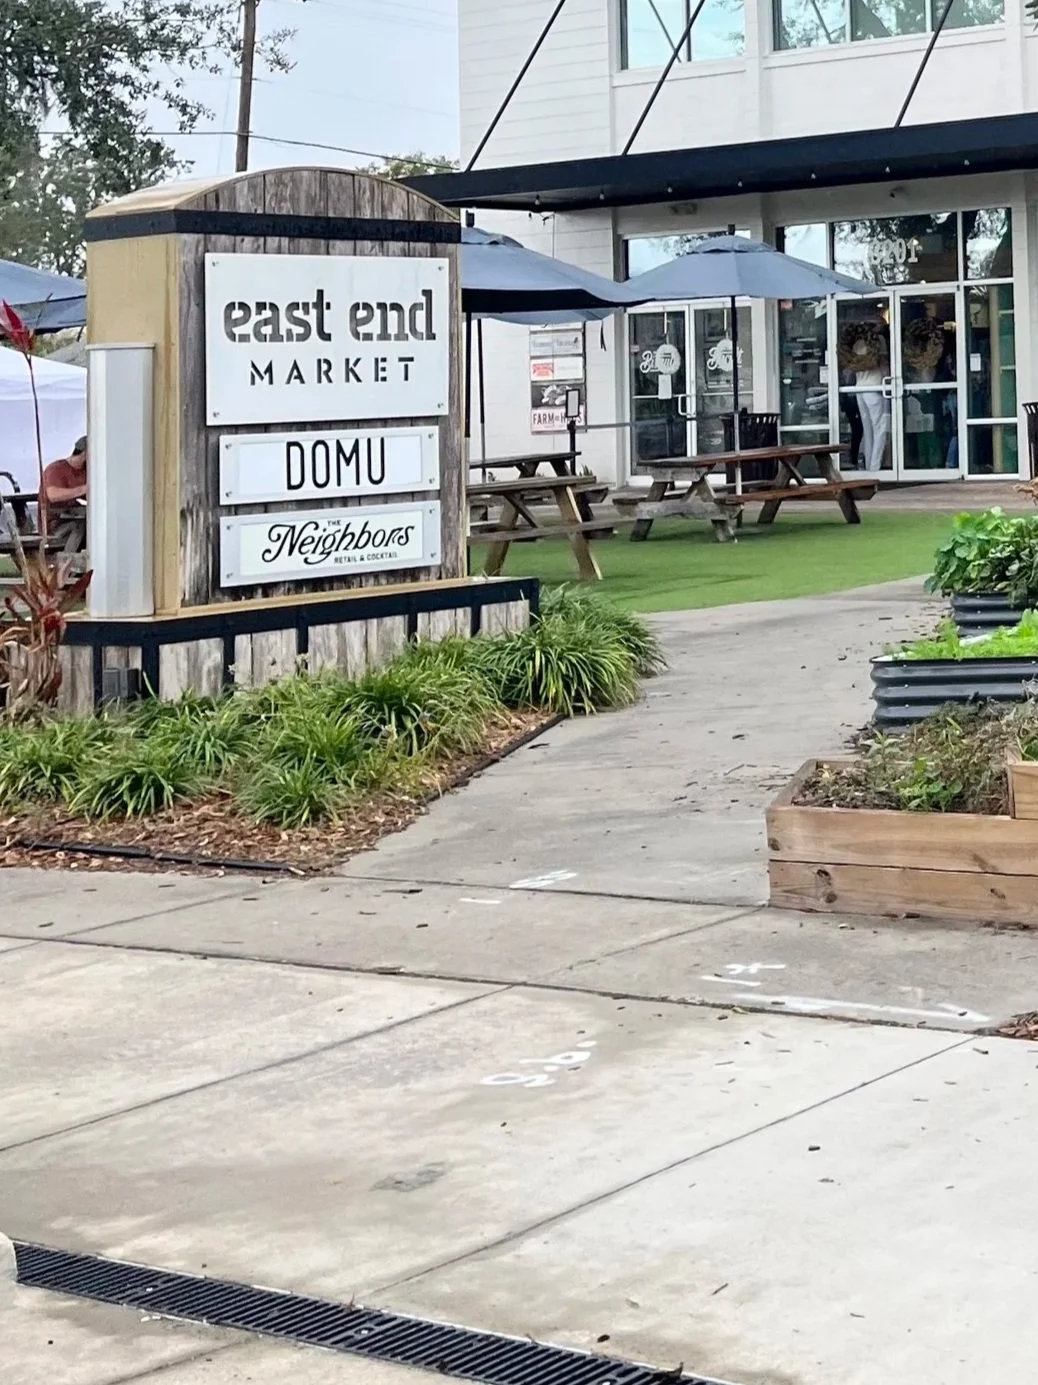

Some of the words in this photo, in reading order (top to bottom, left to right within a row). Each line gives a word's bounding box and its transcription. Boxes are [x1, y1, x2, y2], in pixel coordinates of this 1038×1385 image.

[223, 288, 332, 343] east
[349, 288, 436, 342] end
[250, 356, 415, 386] MARKET
[533, 412, 554, 425] FARM
[285, 436, 386, 491] DOMU
[327, 519, 341, 527] THE
[261, 520, 415, 566] Neighbors
[334, 555, 358, 564] RETAIL
[366, 552, 398, 561] COCKTAIL
